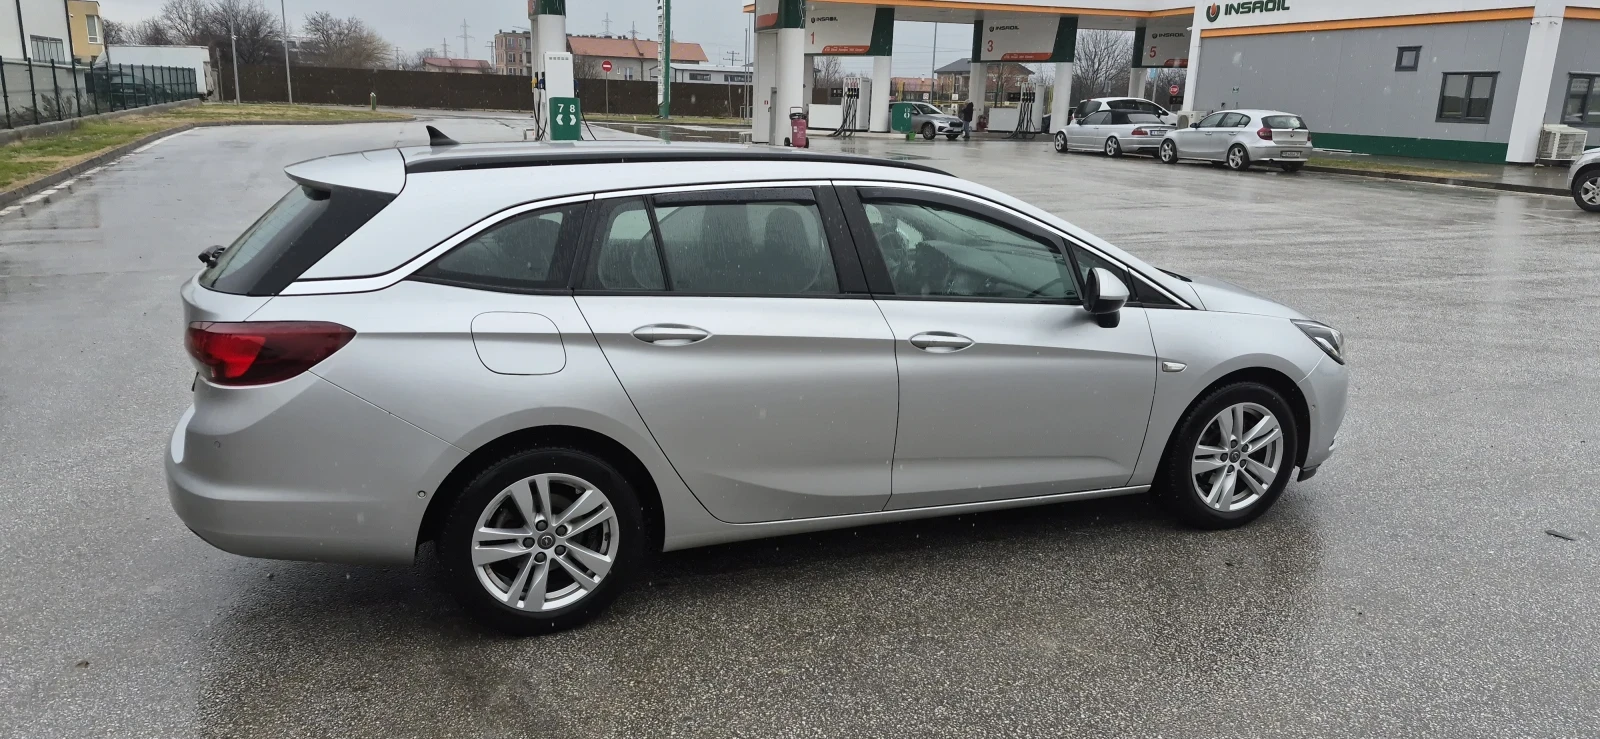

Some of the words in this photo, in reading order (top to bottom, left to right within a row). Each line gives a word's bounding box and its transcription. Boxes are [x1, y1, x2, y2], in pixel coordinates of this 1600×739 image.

[1224, 0, 1290, 15] INSAOIL
[810, 31, 815, 45] 1
[987, 39, 994, 53] 3
[1149, 46, 1157, 58] 5
[558, 104, 564, 112] 7
[570, 104, 576, 112] 8
